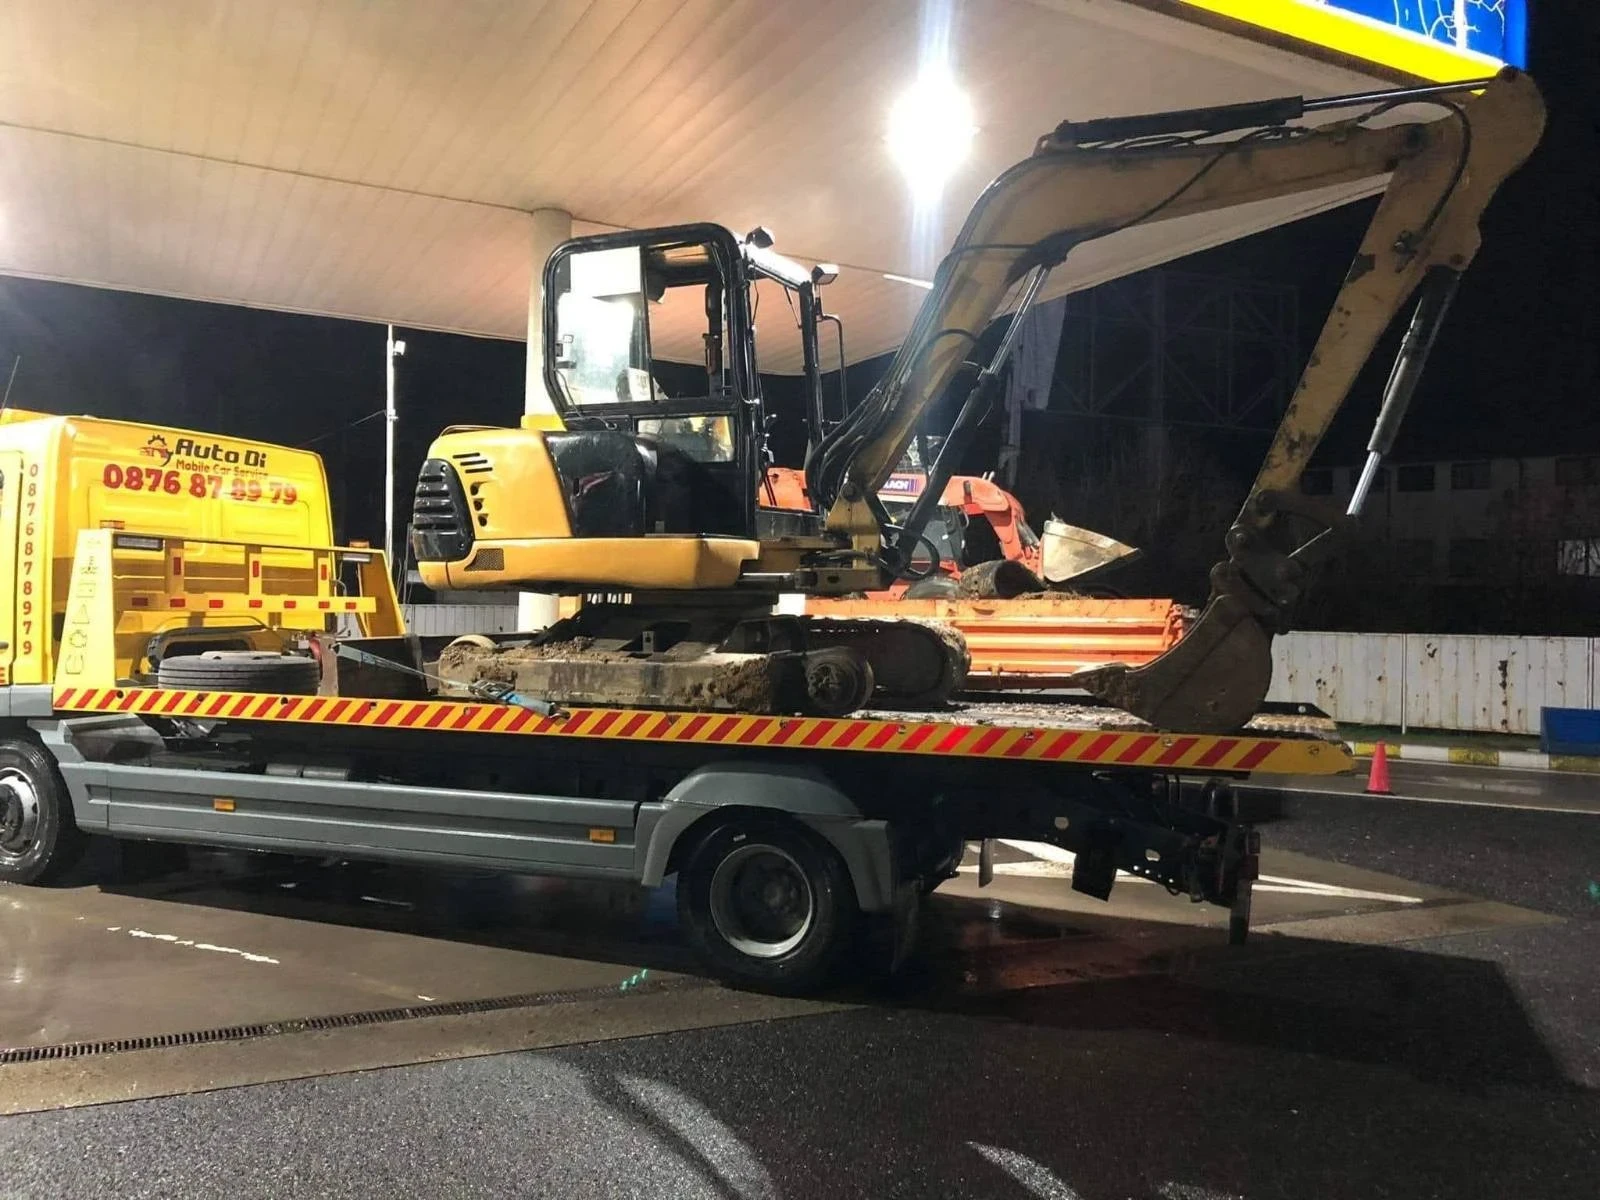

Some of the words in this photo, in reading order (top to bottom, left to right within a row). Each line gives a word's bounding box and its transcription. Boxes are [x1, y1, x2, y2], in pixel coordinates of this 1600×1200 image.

[175, 438, 240, 464] Auto
[243, 450, 267, 468] Di
[176, 459, 210, 474] Mobile
[213, 464, 231, 475] Car
[103, 463, 181, 495] 0876
[188, 473, 223, 499] 87
[230, 478, 262, 503] 89
[269, 481, 298, 505] 79
[22, 463, 39, 655] 0876878979
